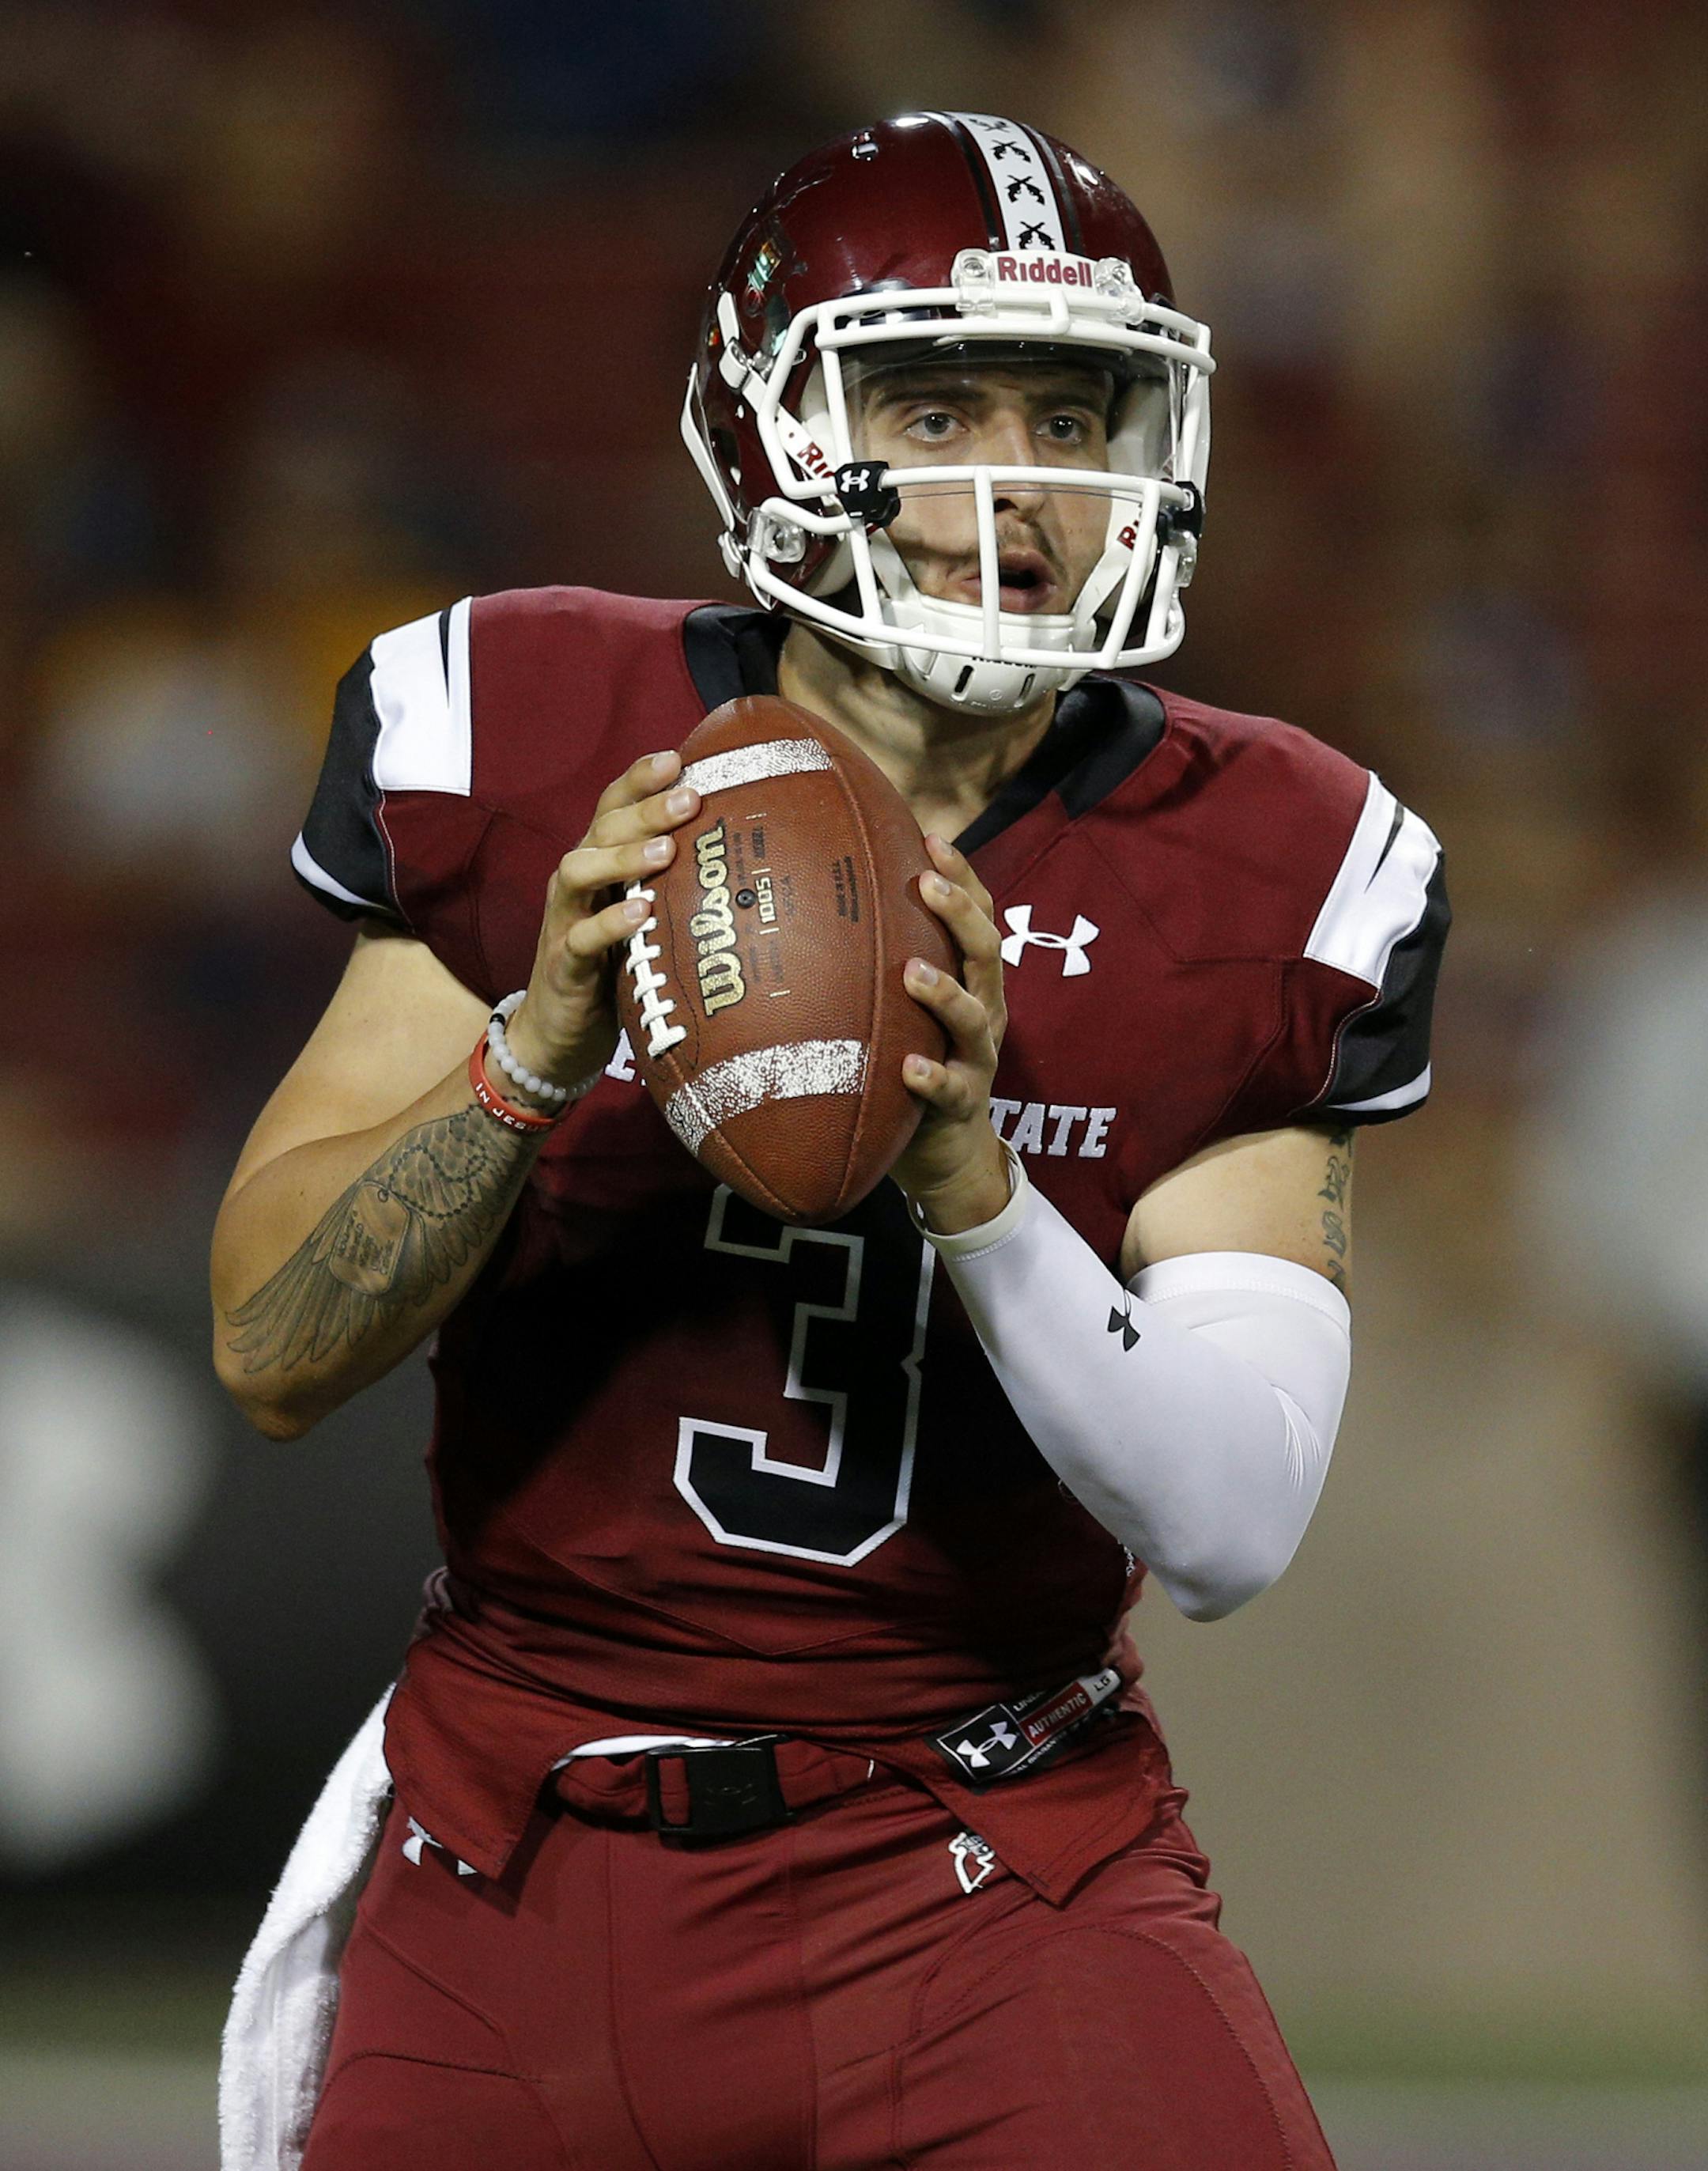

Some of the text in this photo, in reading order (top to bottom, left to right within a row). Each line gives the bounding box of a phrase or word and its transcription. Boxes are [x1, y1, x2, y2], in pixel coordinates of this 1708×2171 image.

[996, 256, 1093, 288] Riddell
[690, 825, 746, 1016] Wilson
[756, 876, 777, 924] 1005
[475, 1083, 490, 1104] IN
[989, 1096, 1117, 1159] TATE
[673, 1183, 937, 1568] 3
[1027, 1693, 1087, 1738] AUTHENTIC
[1094, 1675, 1111, 1691] LG
